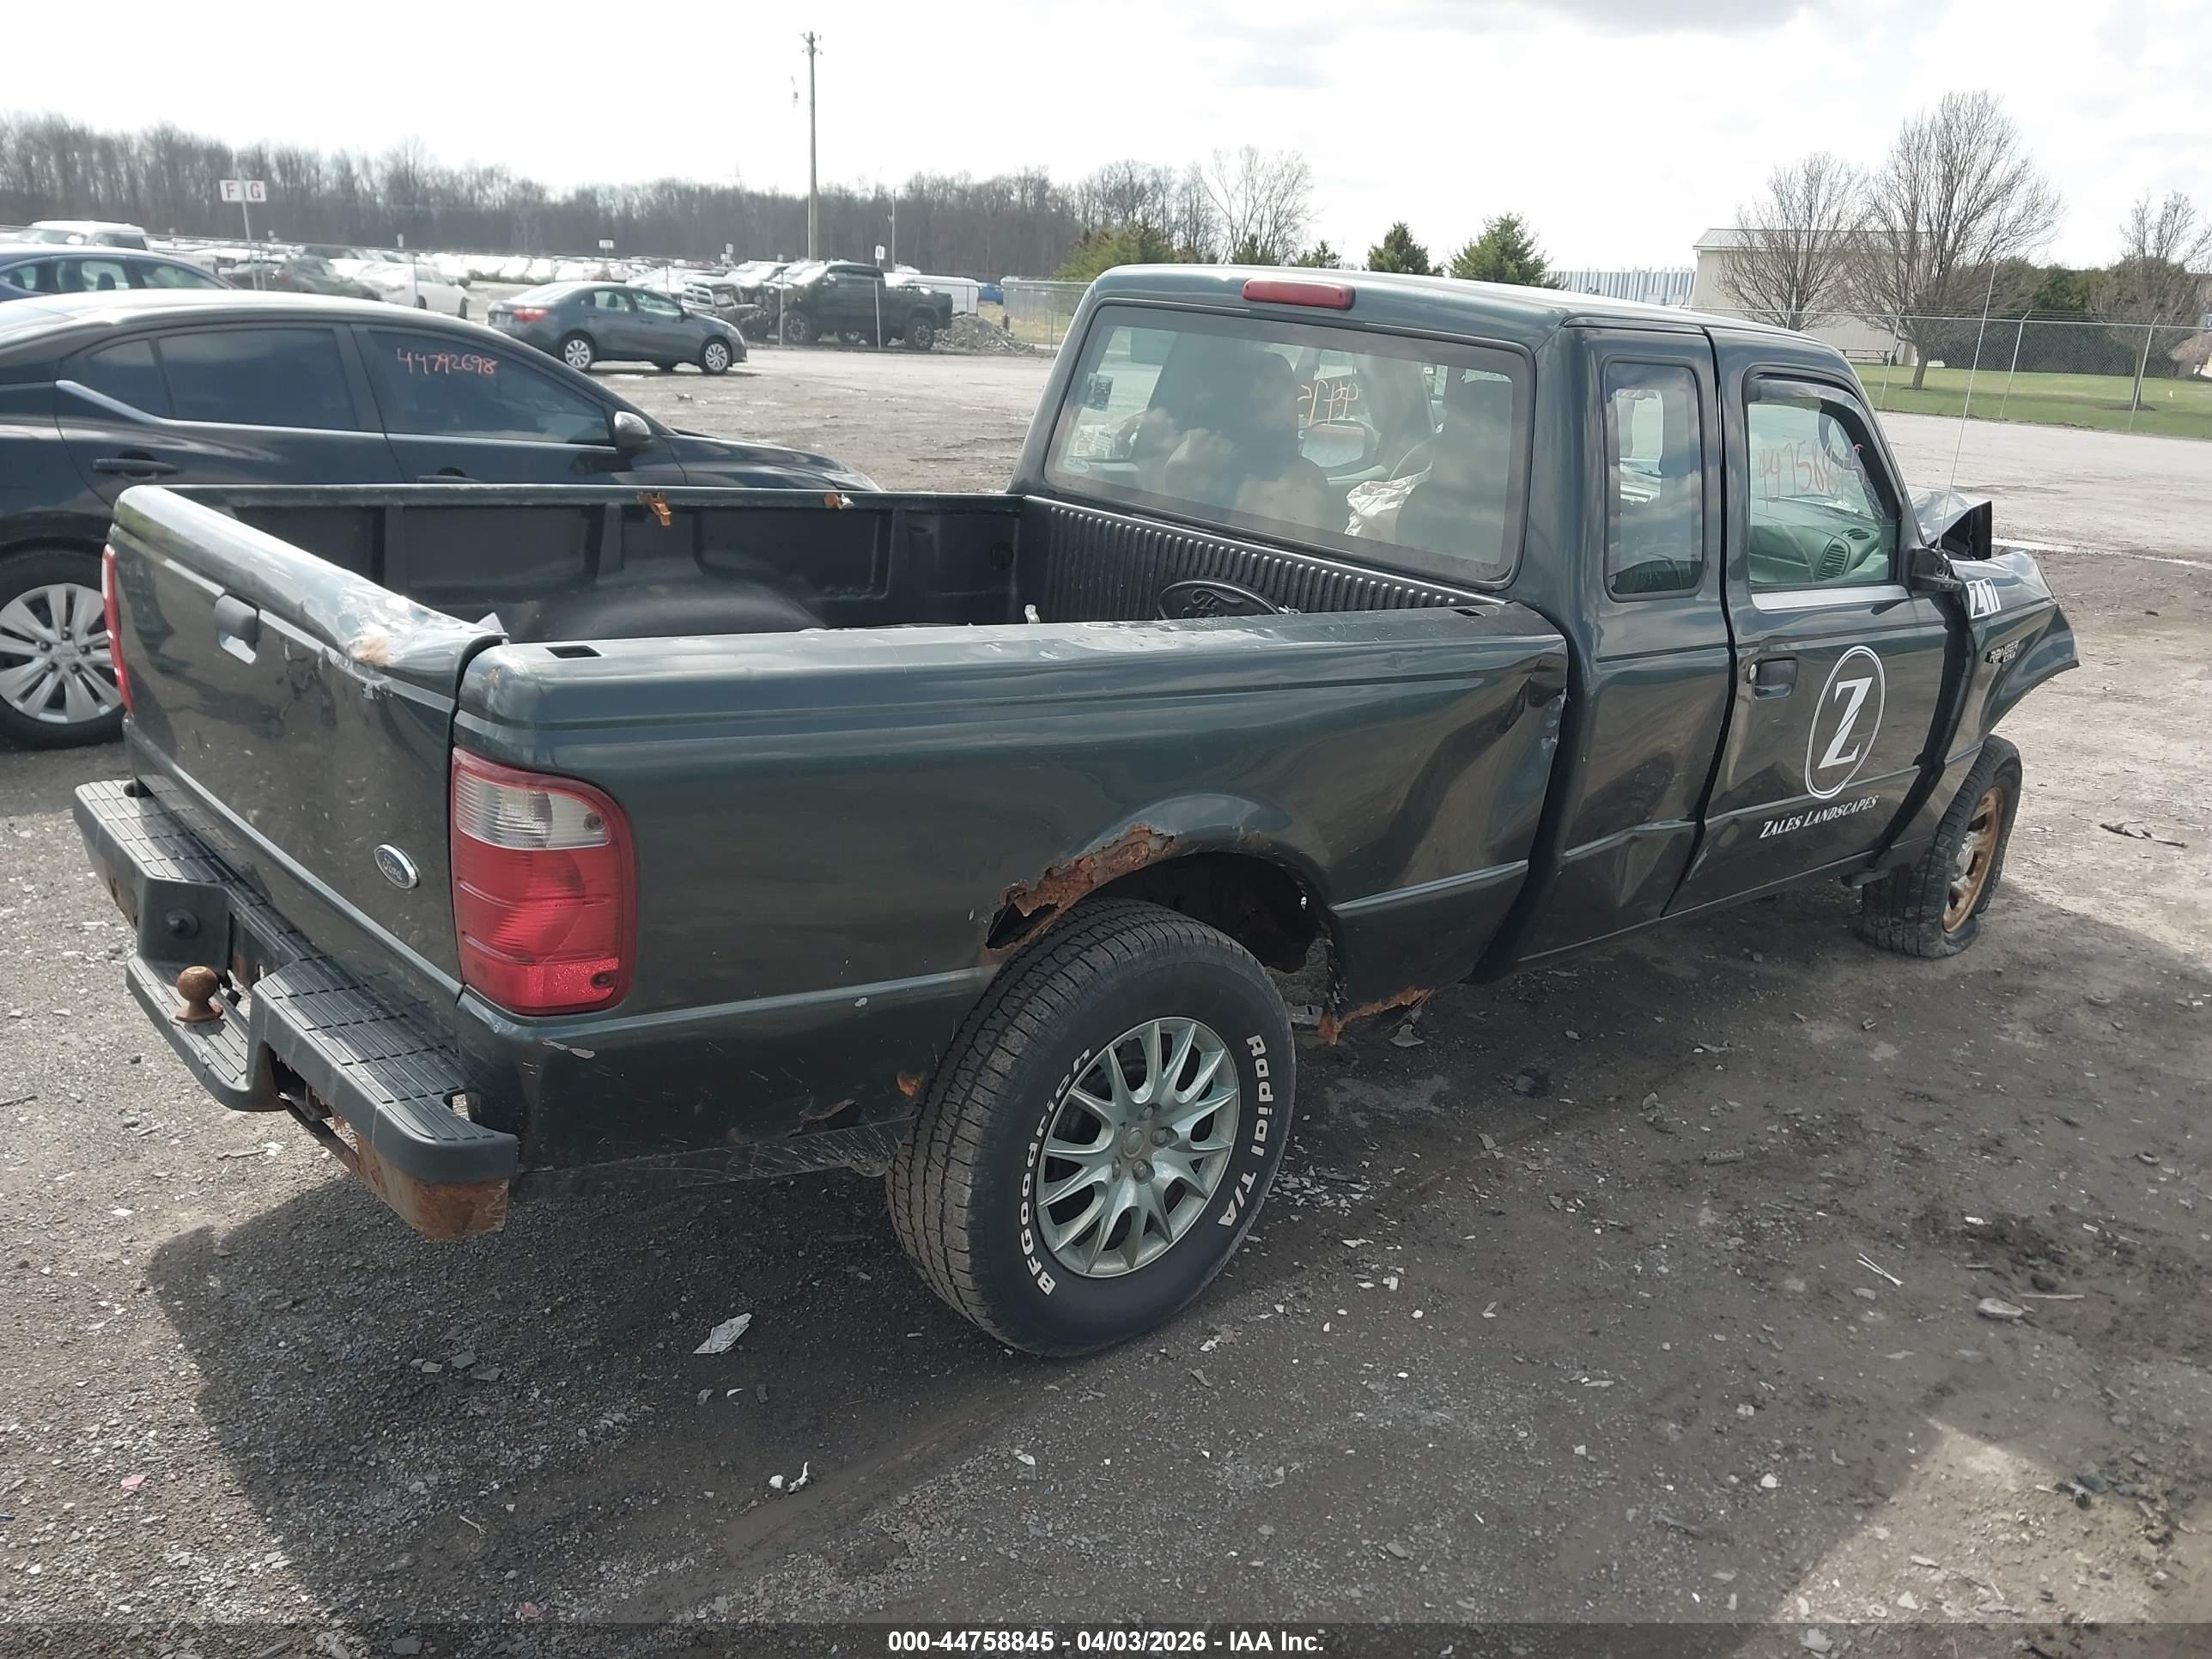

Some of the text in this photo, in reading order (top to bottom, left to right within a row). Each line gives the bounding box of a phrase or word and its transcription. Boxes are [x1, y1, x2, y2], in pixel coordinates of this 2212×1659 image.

[226, 182, 262, 199] F G
[397, 348, 497, 375] 44792698
[1817, 677, 1874, 769] Z
[1217, 1034, 1274, 1227] Radial T/A
